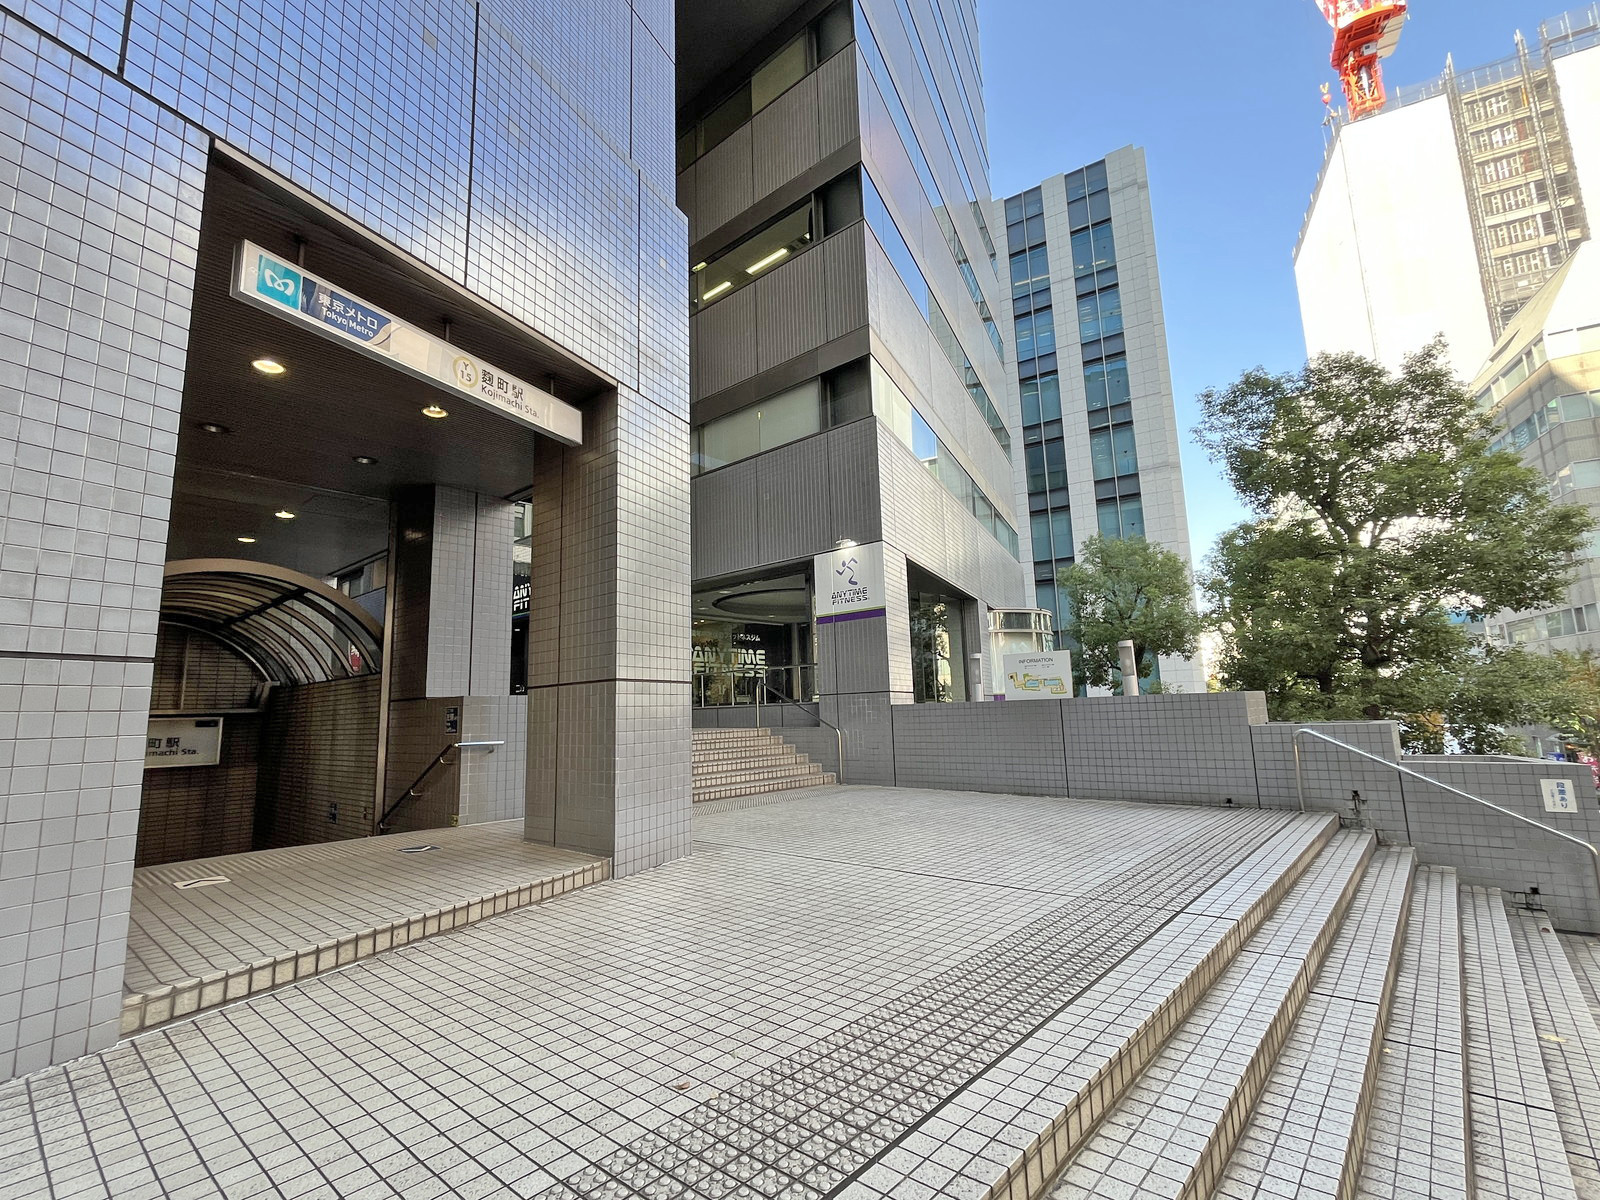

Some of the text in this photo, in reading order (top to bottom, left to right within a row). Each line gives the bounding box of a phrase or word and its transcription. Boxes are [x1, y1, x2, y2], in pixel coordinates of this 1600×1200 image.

[318, 292, 378, 330] 東京メトロ
[321, 306, 374, 338] Tokyo Metro
[462, 361, 469, 371] Y
[460, 370, 472, 382] 15
[481, 384, 540, 418] Kojimachi Sta.
[831, 586, 868, 600] ANYTIME
[832, 594, 868, 606] FITNESS
[692, 645, 766, 665] ANYTIME
